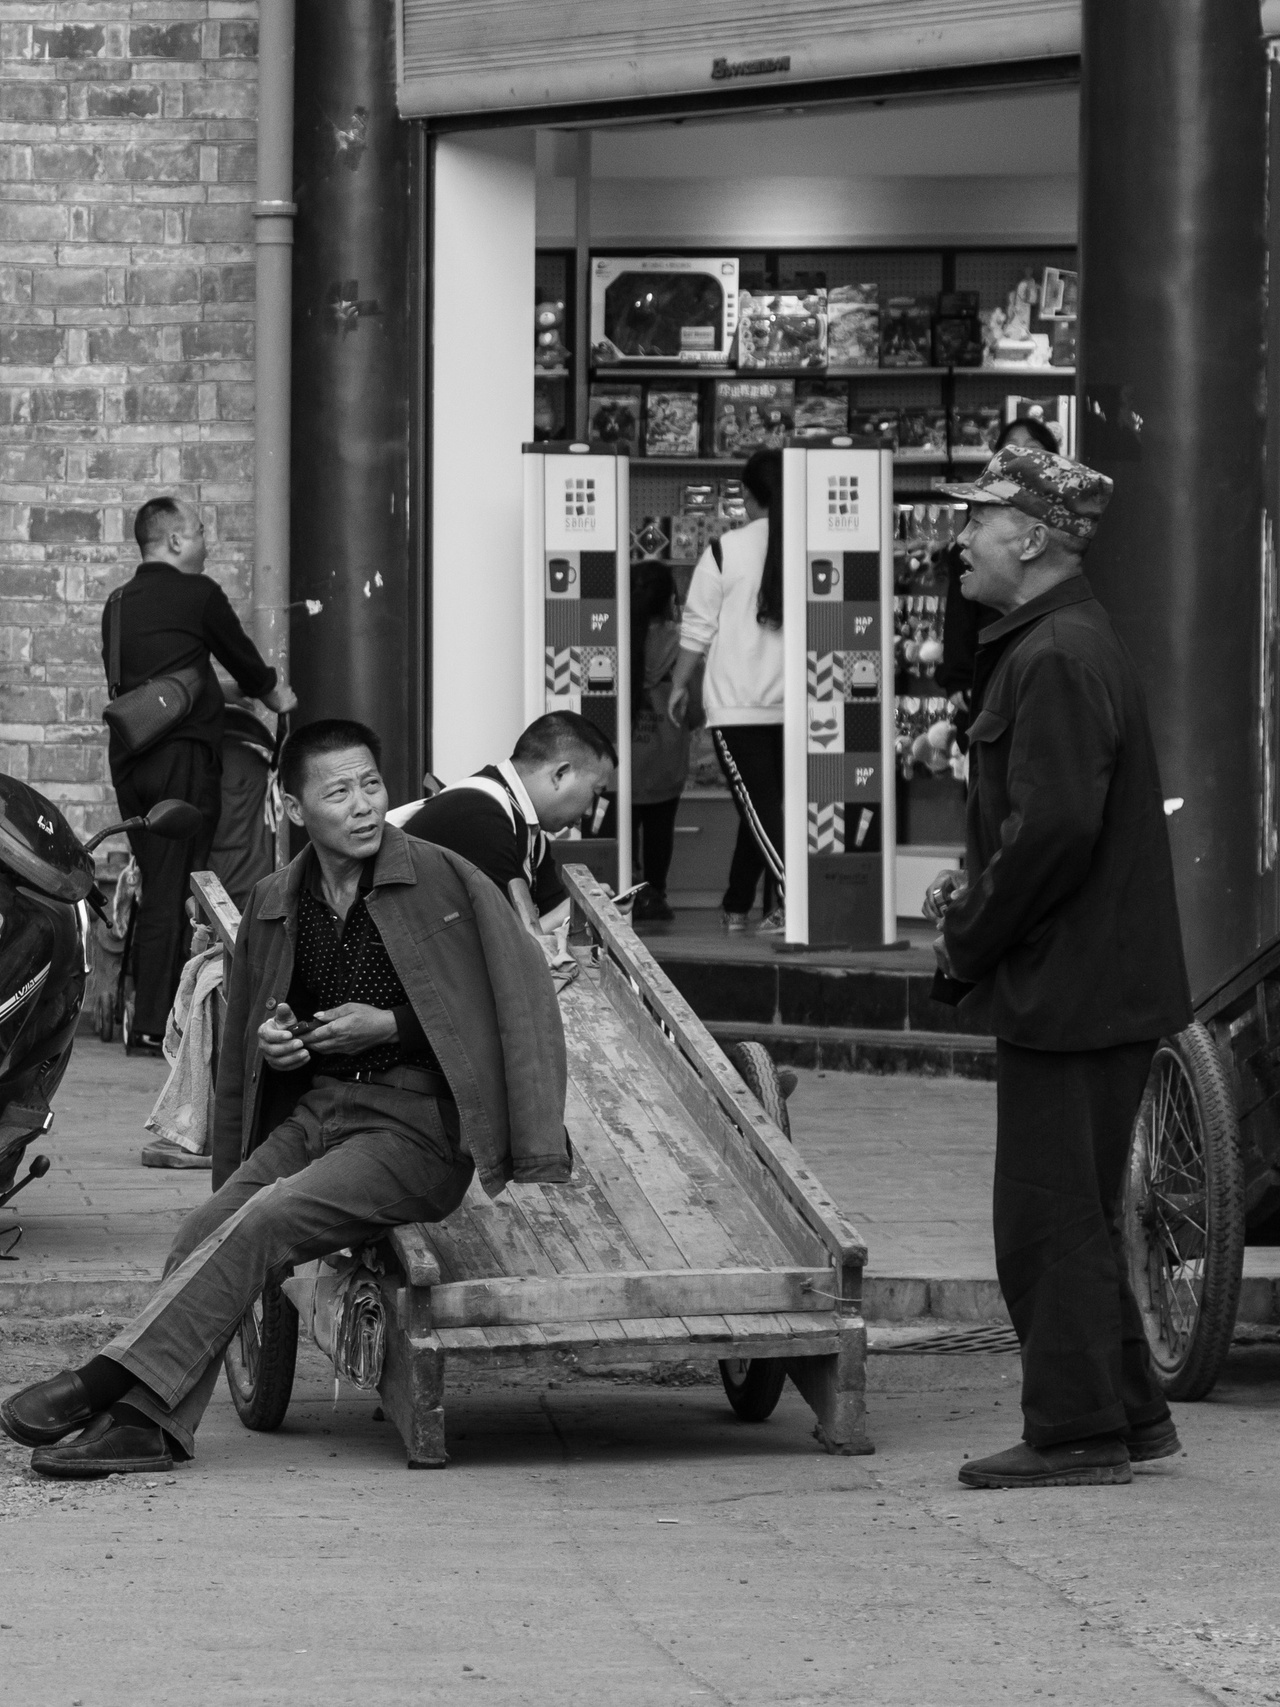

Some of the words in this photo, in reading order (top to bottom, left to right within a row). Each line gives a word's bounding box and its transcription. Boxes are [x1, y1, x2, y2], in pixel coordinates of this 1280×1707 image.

[591, 613, 609, 622] HAP
[855, 616, 873, 626] HAP
[591, 622, 603, 631] PY
[855, 626, 867, 635] PY
[855, 767, 874, 777] HAP
[855, 777, 867, 786] PY
